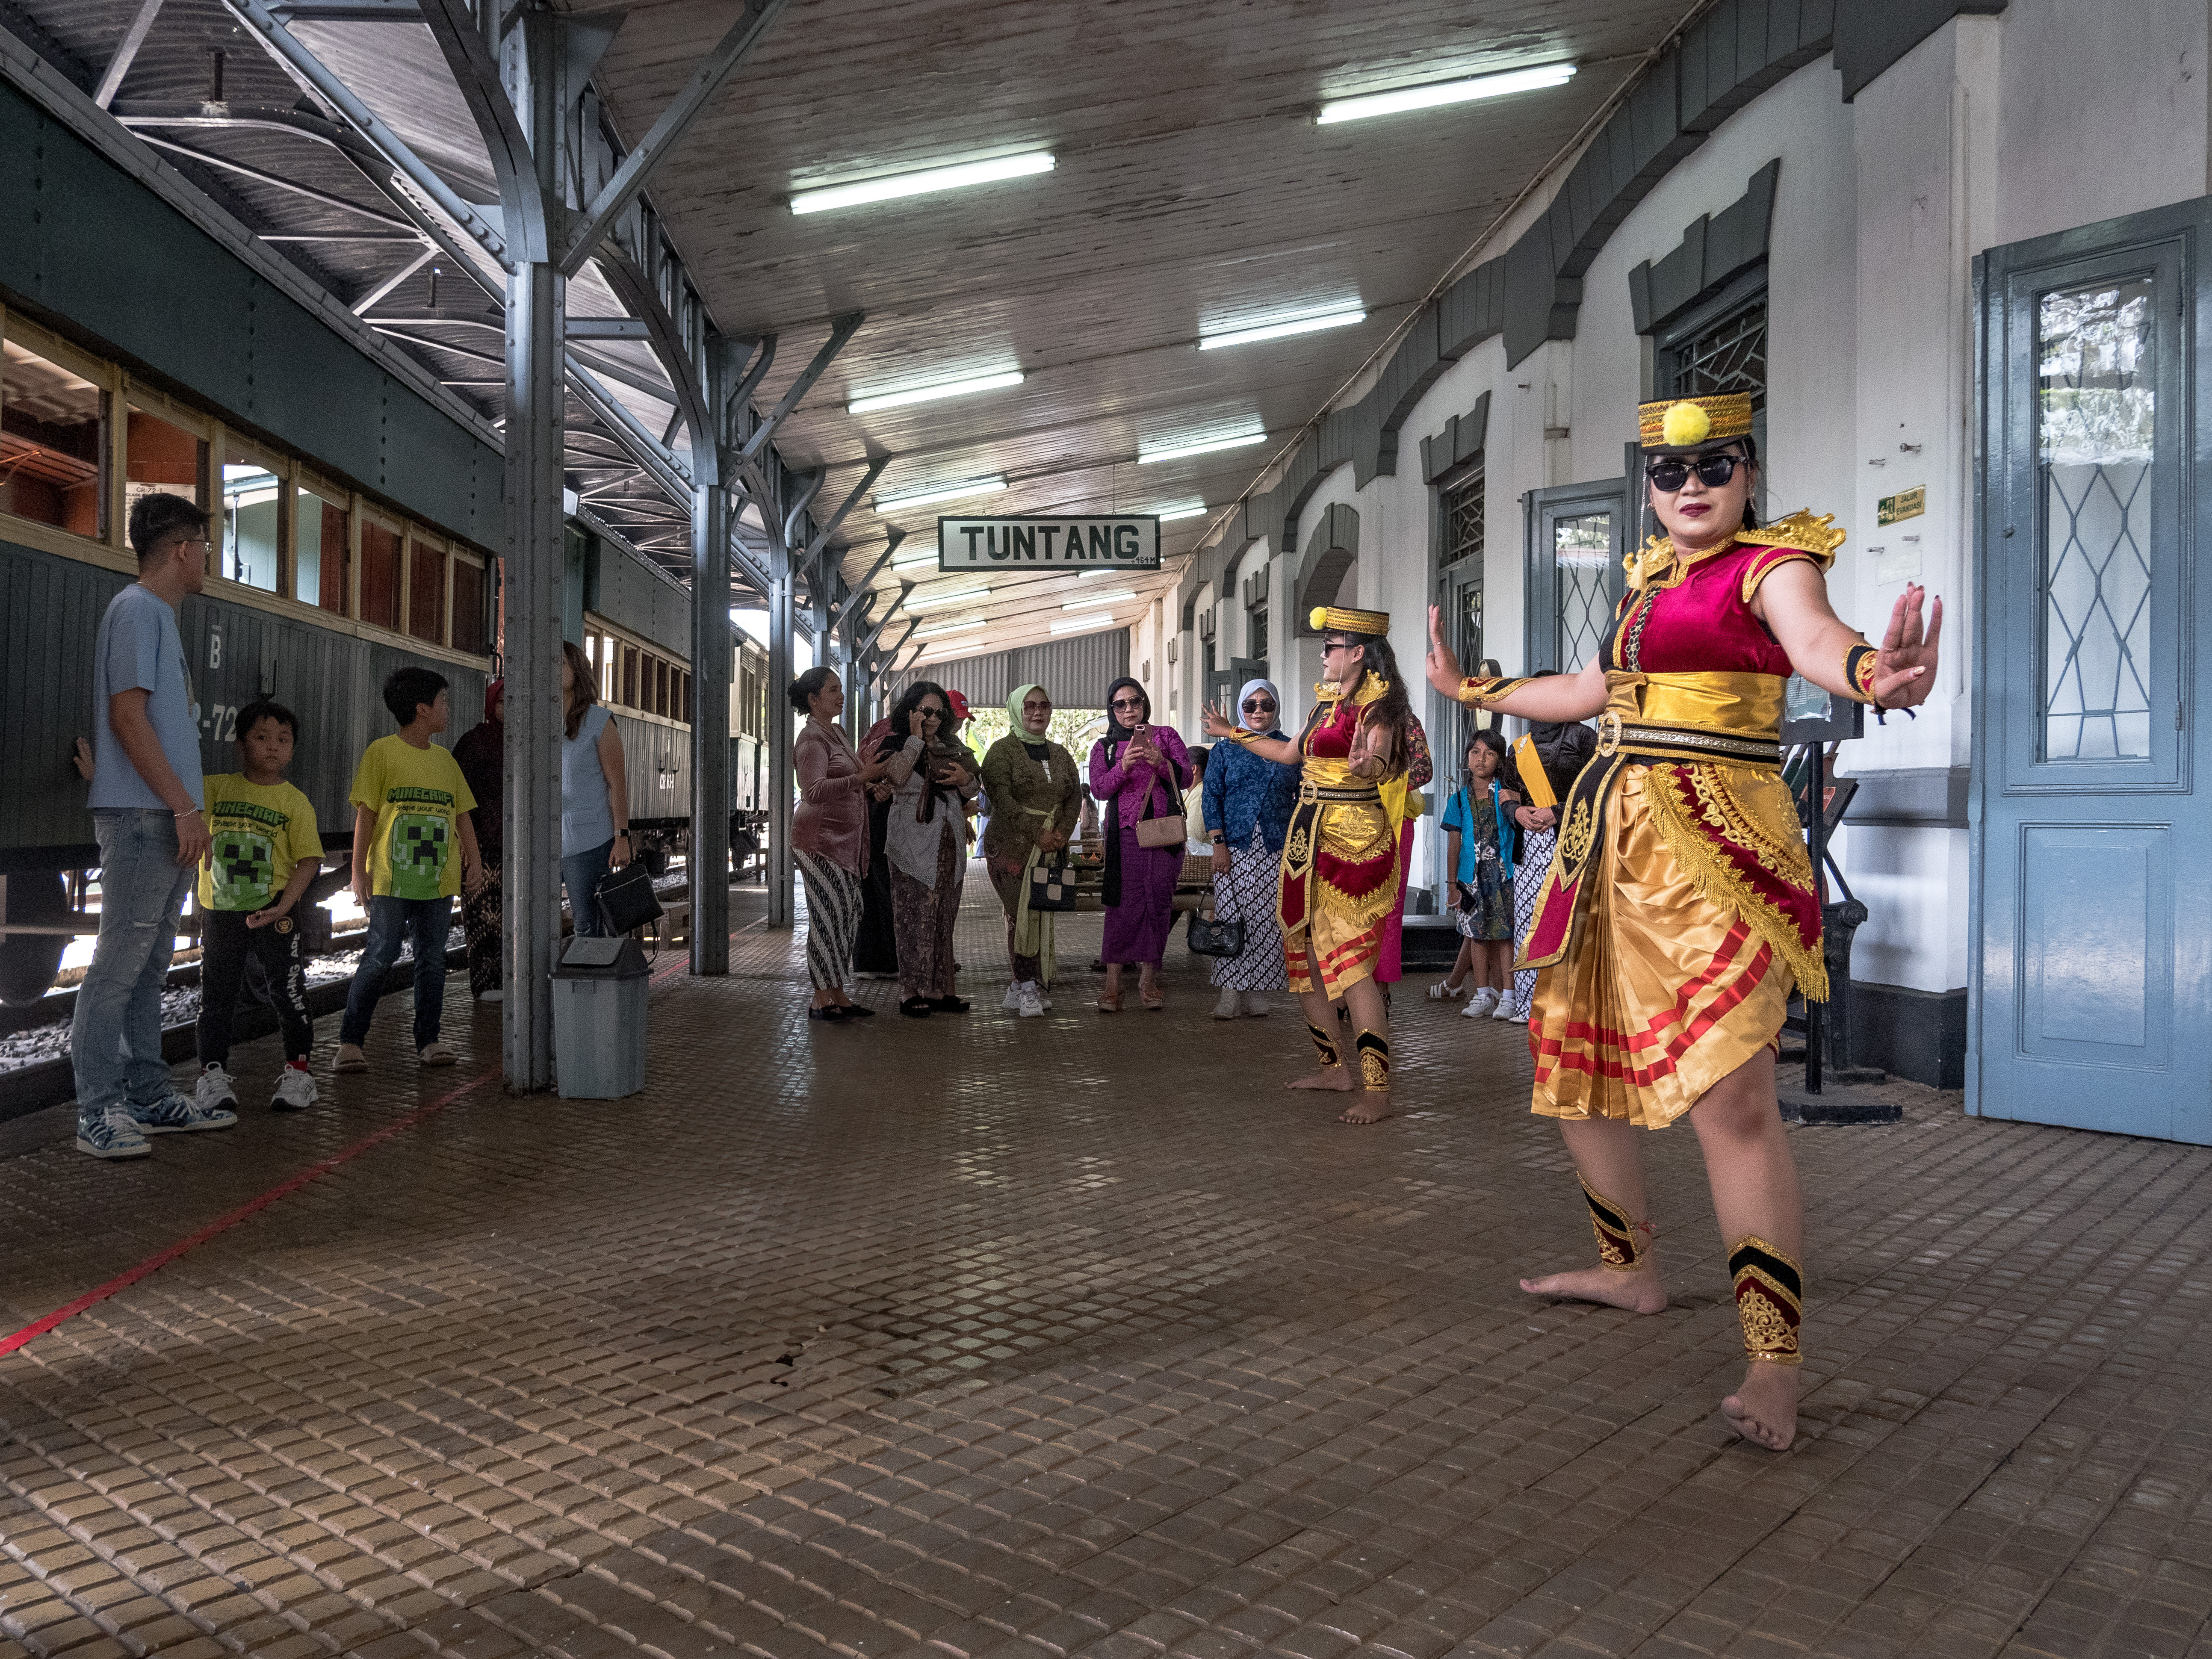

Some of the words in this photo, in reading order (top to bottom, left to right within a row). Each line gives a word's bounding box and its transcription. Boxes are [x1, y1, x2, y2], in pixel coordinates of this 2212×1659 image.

[1896, 501, 1922, 515] EVAKUASI
[1900, 492, 1917, 503] JALUR
[960, 525, 1139, 560] TUNTANG
[194, 702, 238, 742] -72
